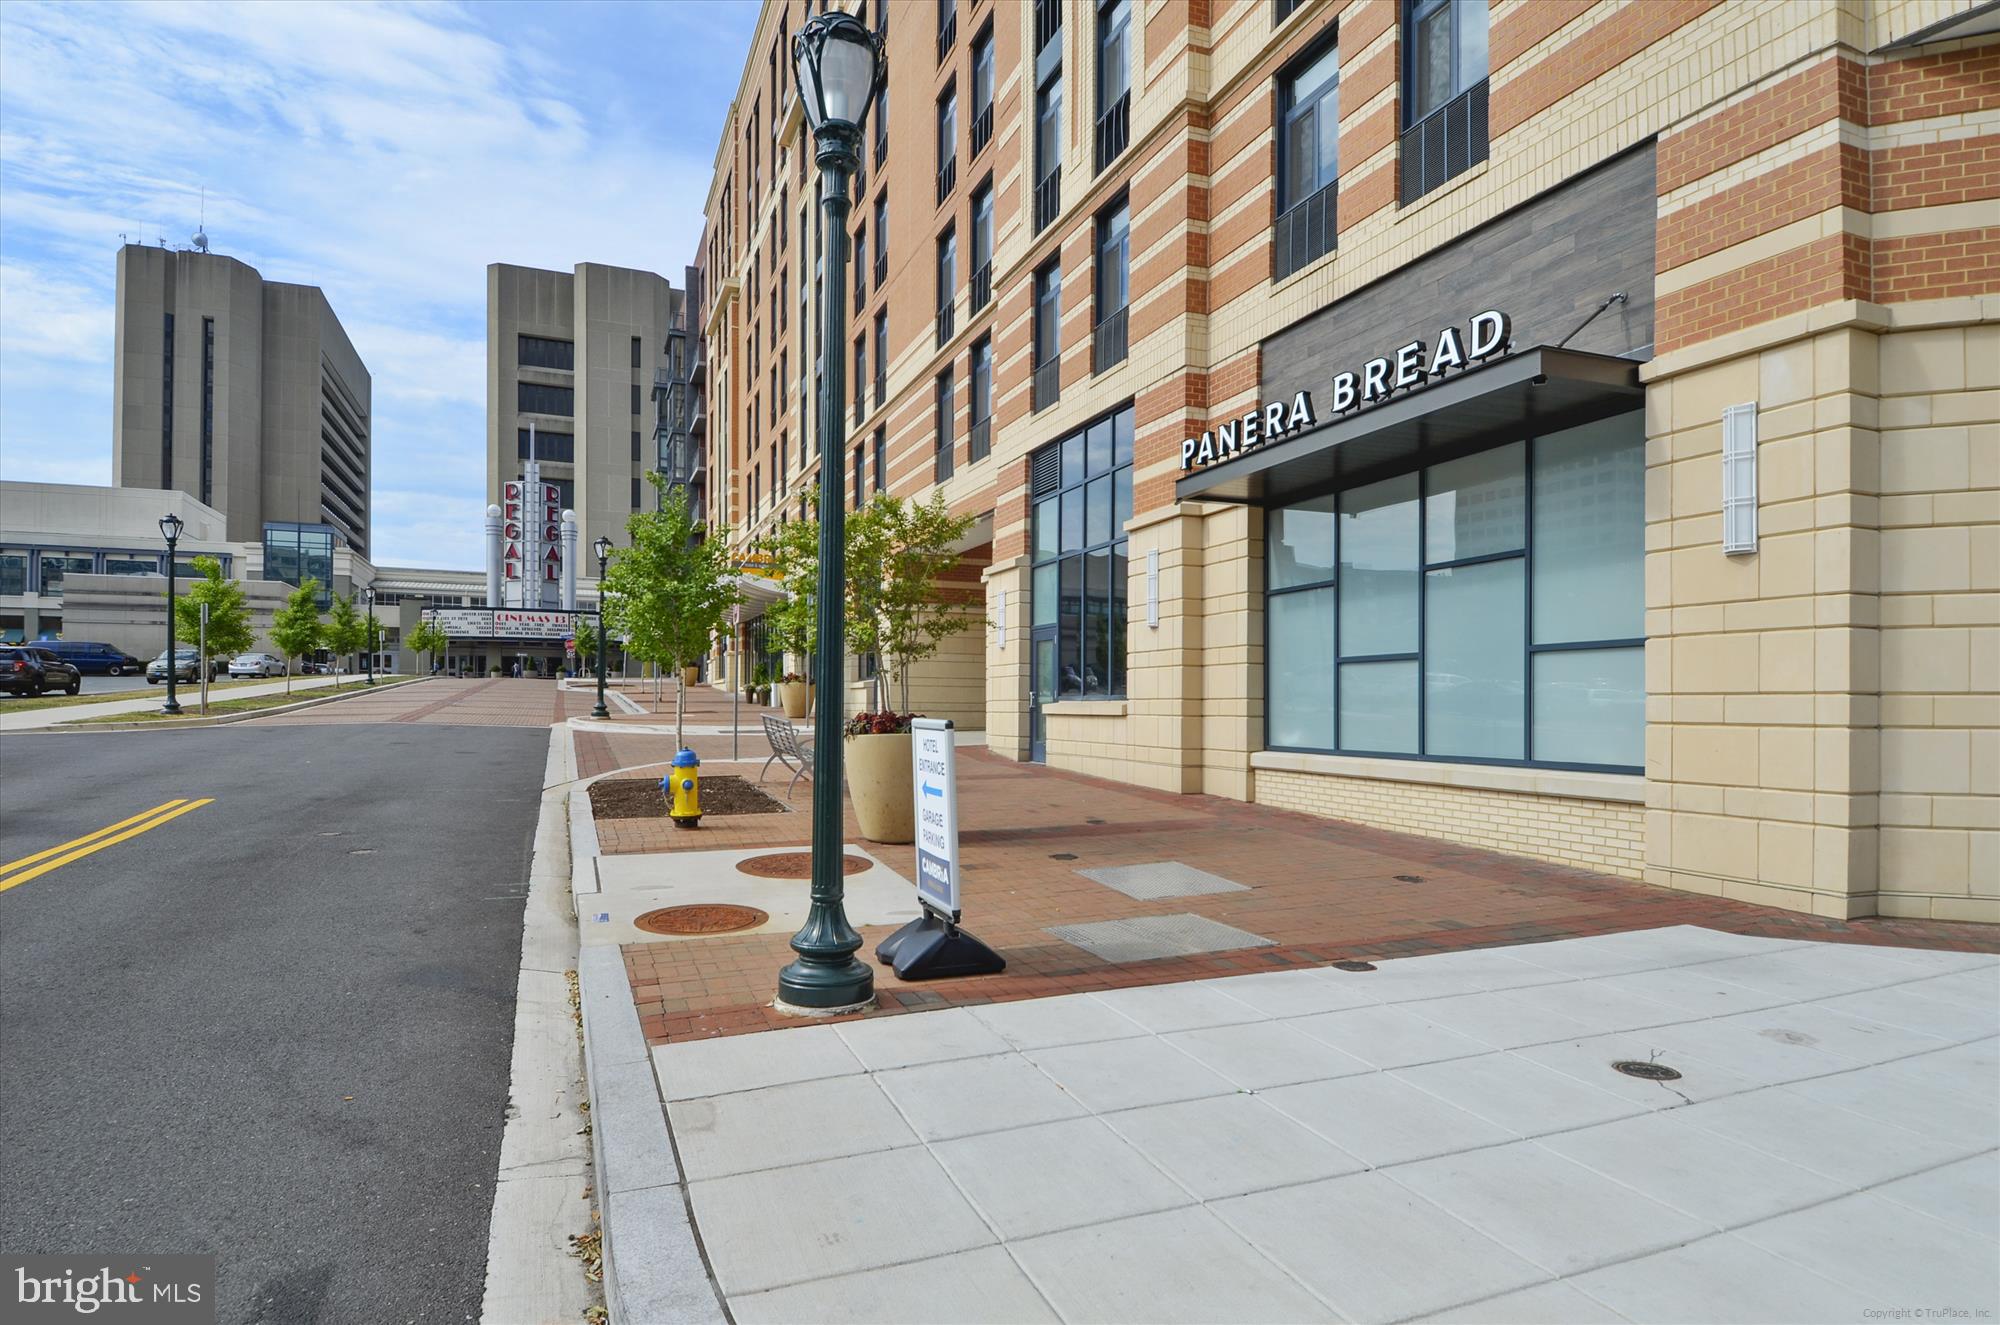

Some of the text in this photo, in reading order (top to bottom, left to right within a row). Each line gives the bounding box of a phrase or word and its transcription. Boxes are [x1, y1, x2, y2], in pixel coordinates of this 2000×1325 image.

[1179, 309, 1513, 471] PANERA BREAD
[504, 483, 520, 579] REGAL
[544, 486, 560, 580] REGAL
[496, 613, 550, 623] CINEMAS
[923, 737, 939, 753] HOTEL
[919, 758, 945, 776] ENTRANCE
[922, 808, 944, 828] GARAGE
[922, 828, 945, 849] PARKING
